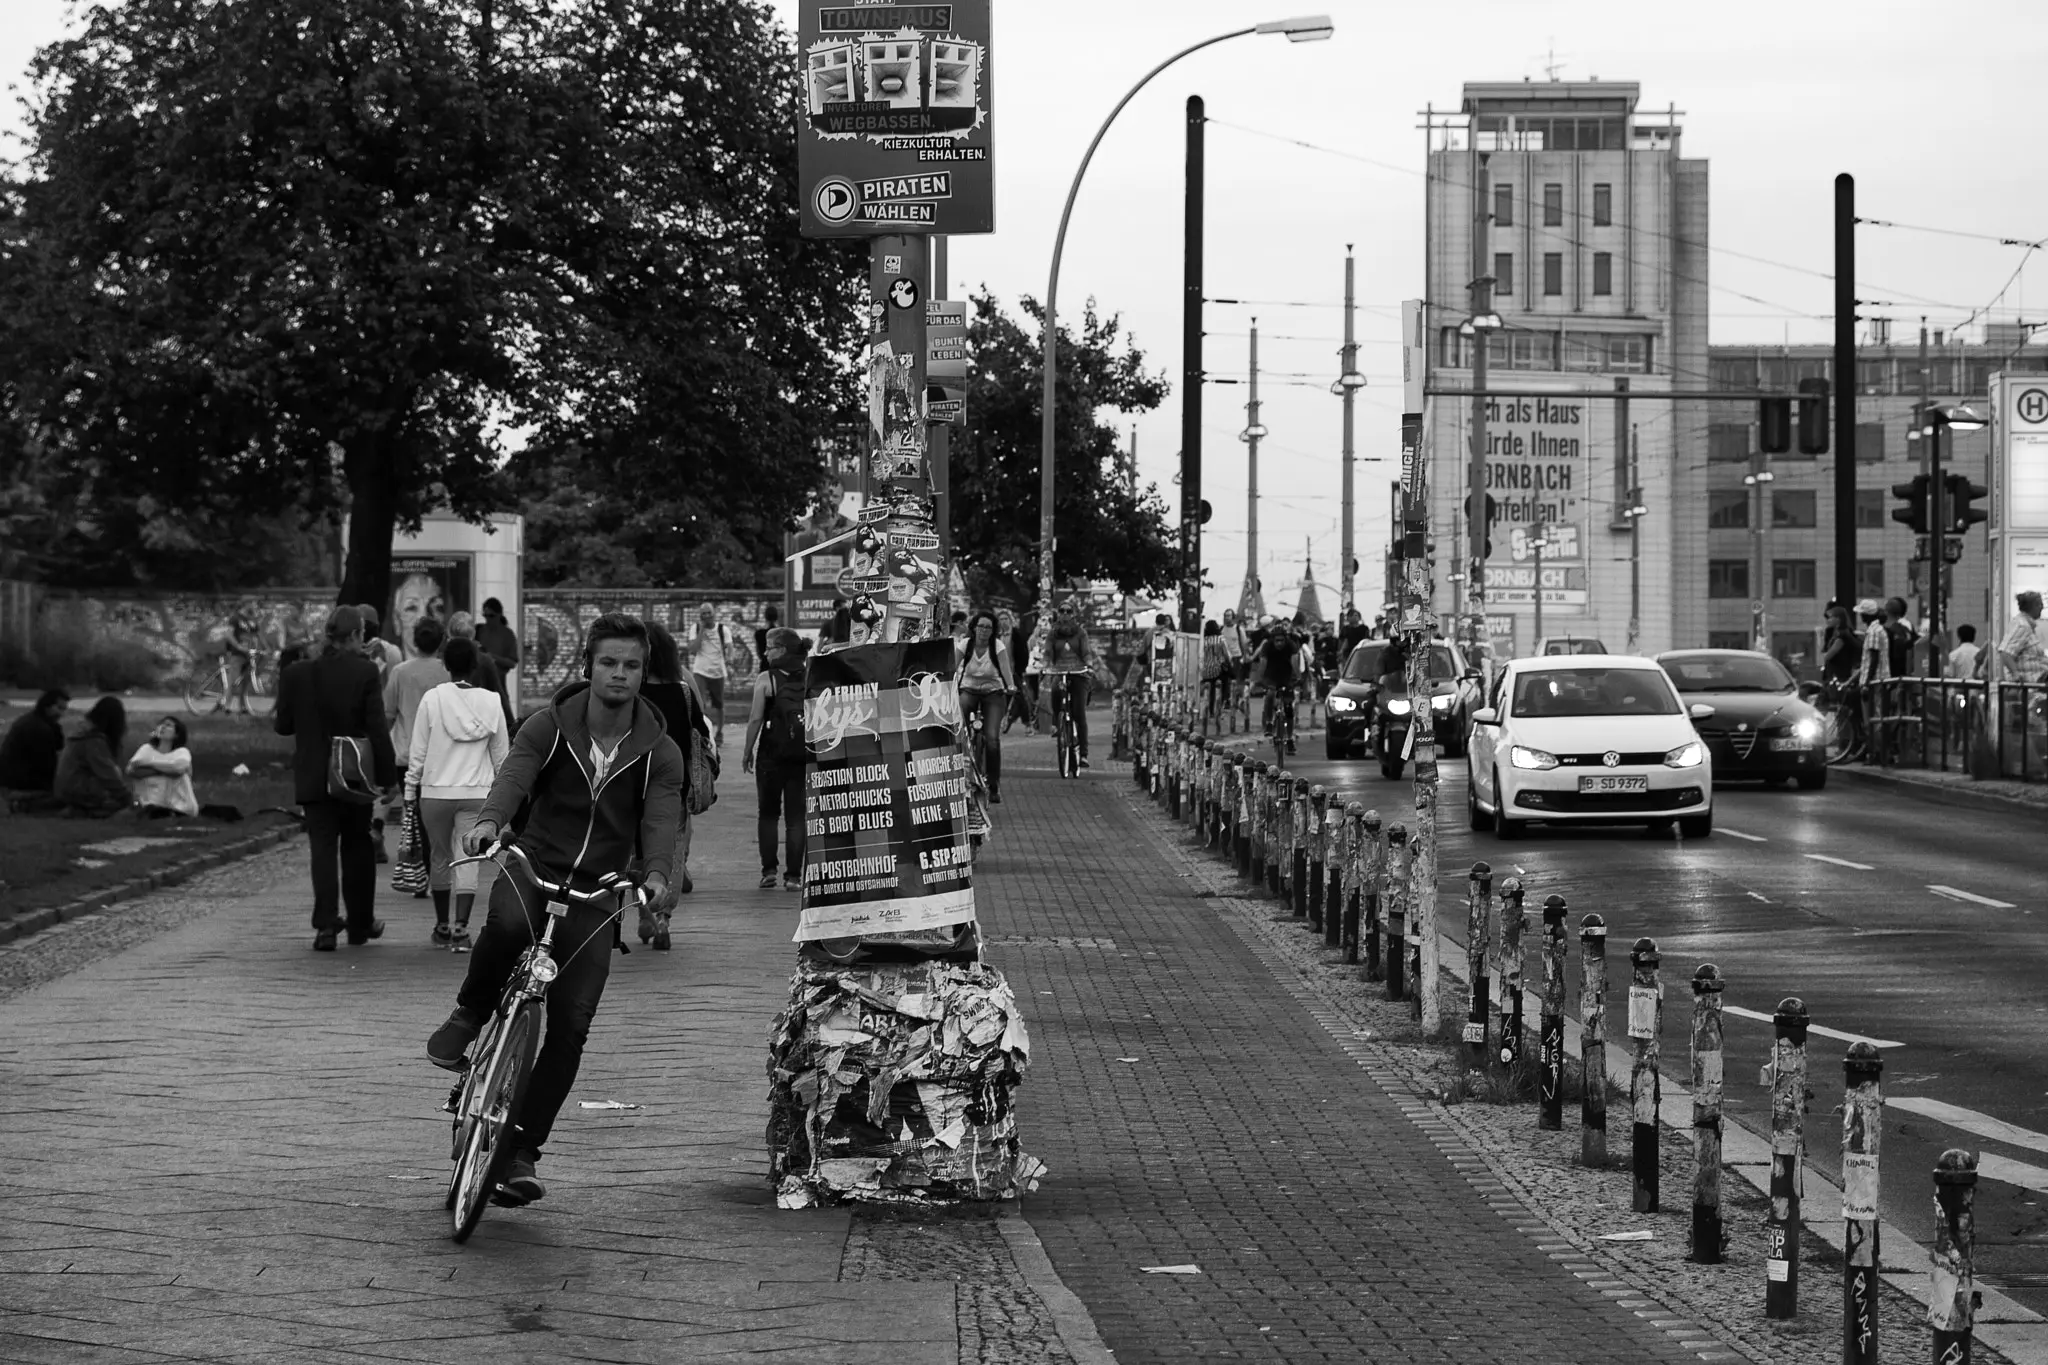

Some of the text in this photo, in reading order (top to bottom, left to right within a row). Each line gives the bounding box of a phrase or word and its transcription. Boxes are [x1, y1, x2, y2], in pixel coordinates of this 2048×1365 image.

[823, 9, 948, 28] TOWNHAUS
[824, 103, 890, 113] INVESTOREN
[829, 115, 936, 131] WEGBASSEN.
[884, 139, 951, 150] KIEZKULTUR
[919, 149, 986, 160] ERHALTEN.
[863, 176, 947, 199] PIRATEN
[864, 203, 931, 220] WÄHLEN
[943, 316, 961, 325] DAS
[934, 337, 964, 346] BUNTE
[932, 351, 961, 360] LEBEN
[1506, 397, 1532, 422] als
[2026, 397, 2043, 416] H
[1531, 430, 1579, 457] Ihnen
[834, 682, 879, 703] FRIDAY
[811, 763, 890, 789] SEBASTIAN BLOCK
[905, 761, 916, 779] LA
[917, 755, 952, 776] MARCHE
[907, 780, 947, 803] FOSBURY
[1586, 777, 1647, 789] B SD 9372
[828, 814, 854, 834] BABY
[858, 810, 894, 831] BLUES
[911, 804, 943, 826] MEINE
[821, 854, 897, 880] POSTBAHNHOF
[823, 882, 845, 895] DIREKT
[845, 881, 855, 893] AM
[855, 876, 899, 892] OSTBAHNHOF
